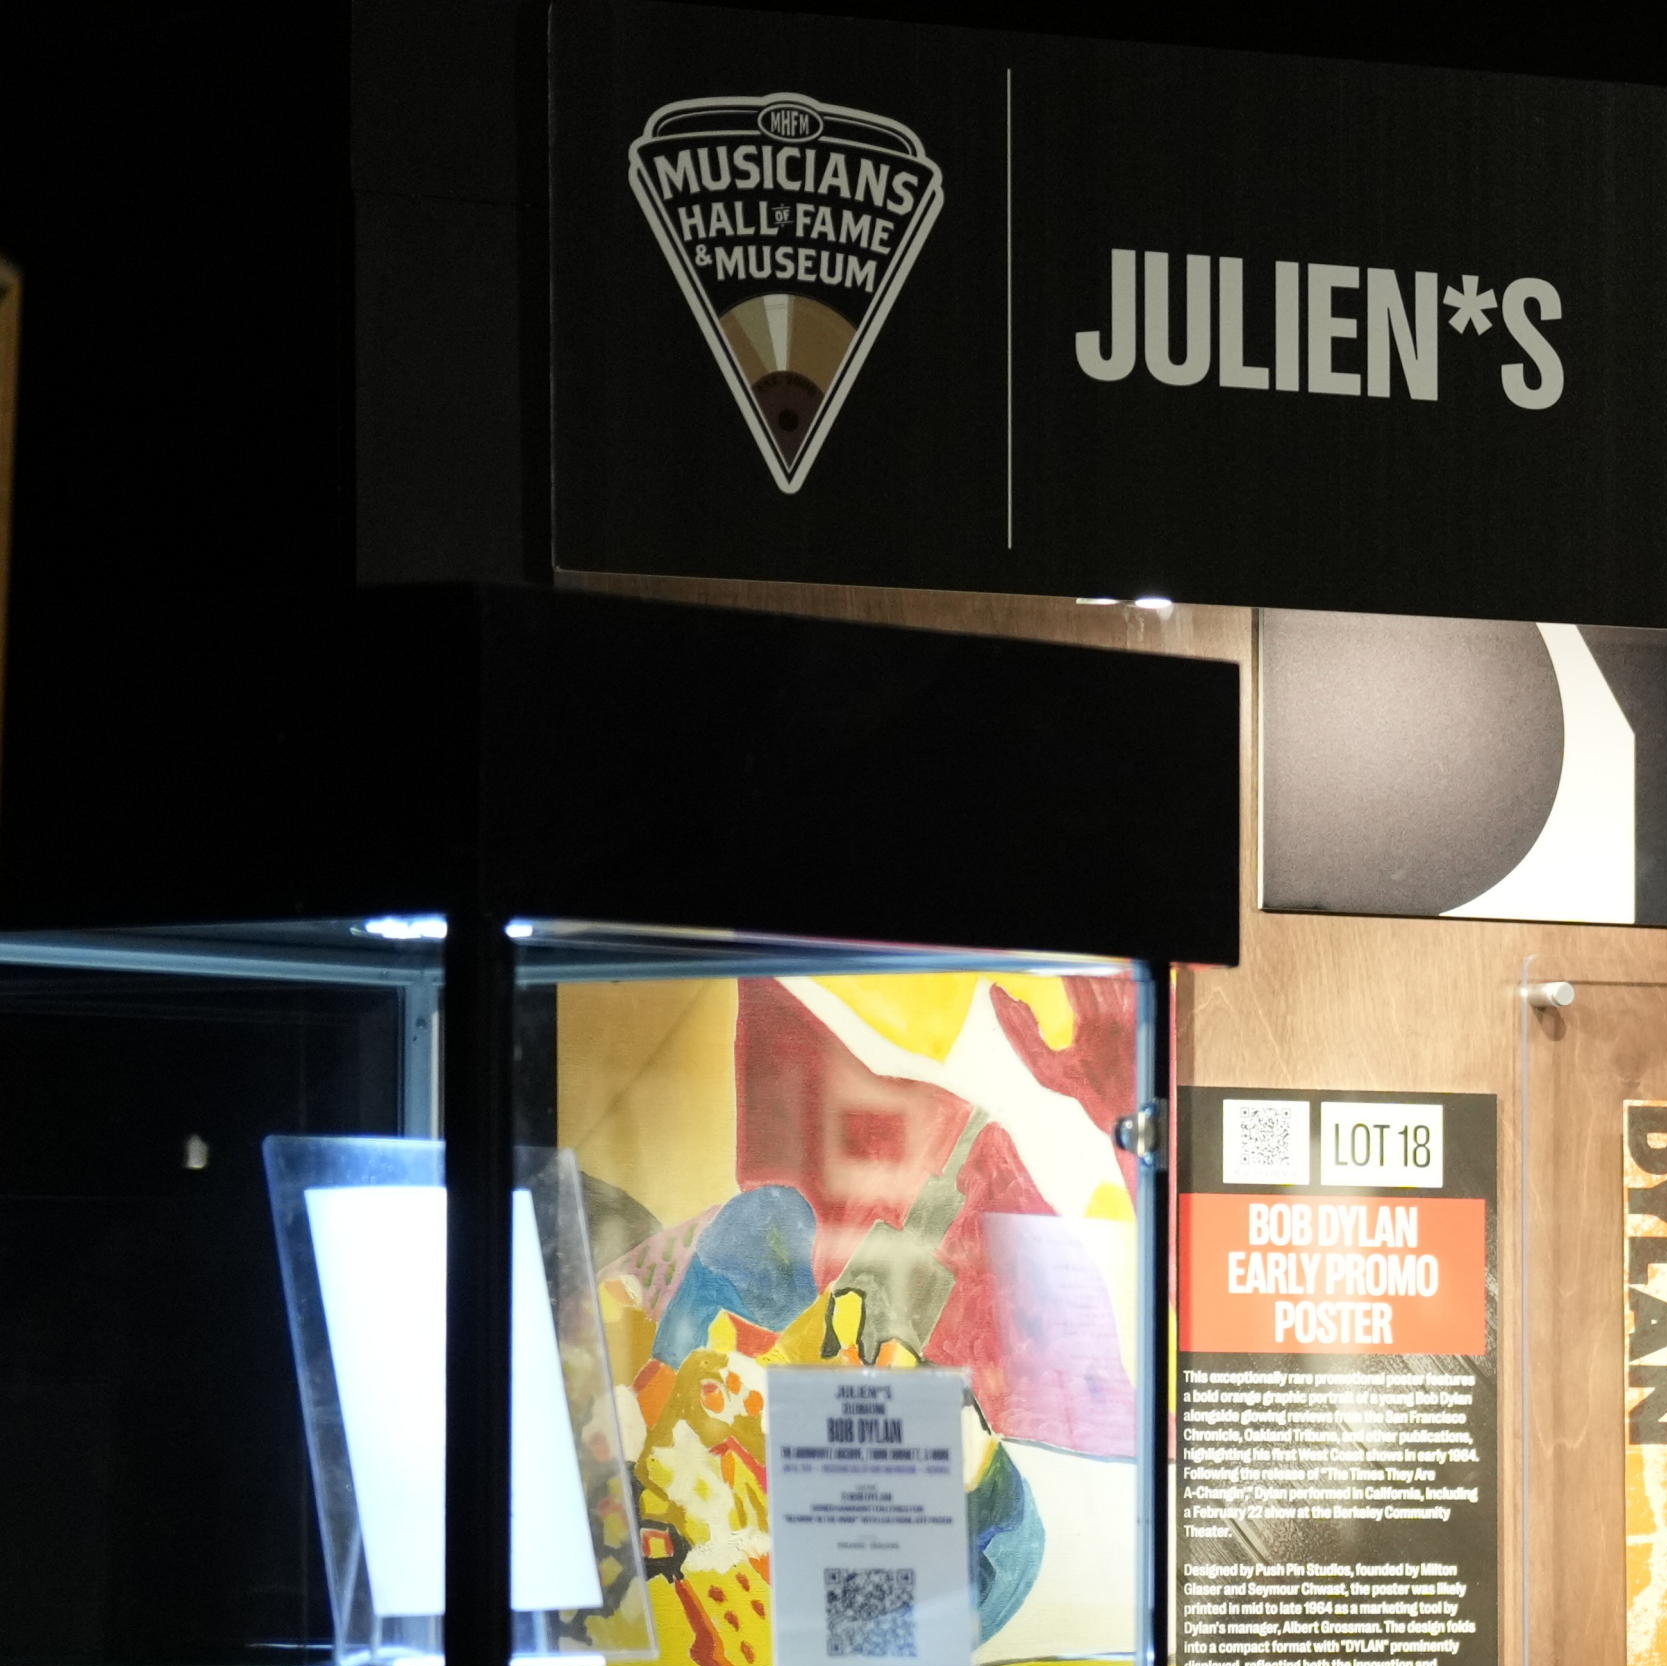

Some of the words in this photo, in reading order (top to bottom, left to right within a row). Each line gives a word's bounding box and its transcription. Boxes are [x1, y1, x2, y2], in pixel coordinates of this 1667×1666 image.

[771, 110, 809, 136] MHFM
[654, 145, 918, 215] MUSICIANS
[678, 201, 778, 241] HALL
[775, 209, 790, 221] OF
[796, 203, 894, 254] FAME
[695, 244, 712, 267] &
[715, 245, 877, 292] MUSEUM
[1334, 1122, 1391, 1168] LOT
[1397, 1124, 1431, 1168] 18
[1249, 1203, 1313, 1246] BOB
[1318, 1204, 1418, 1248] DYLAN
[1228, 1252, 1321, 1295] EARLY
[1325, 1254, 1439, 1297] PROMO
[1275, 1301, 1393, 1344] POSTER
